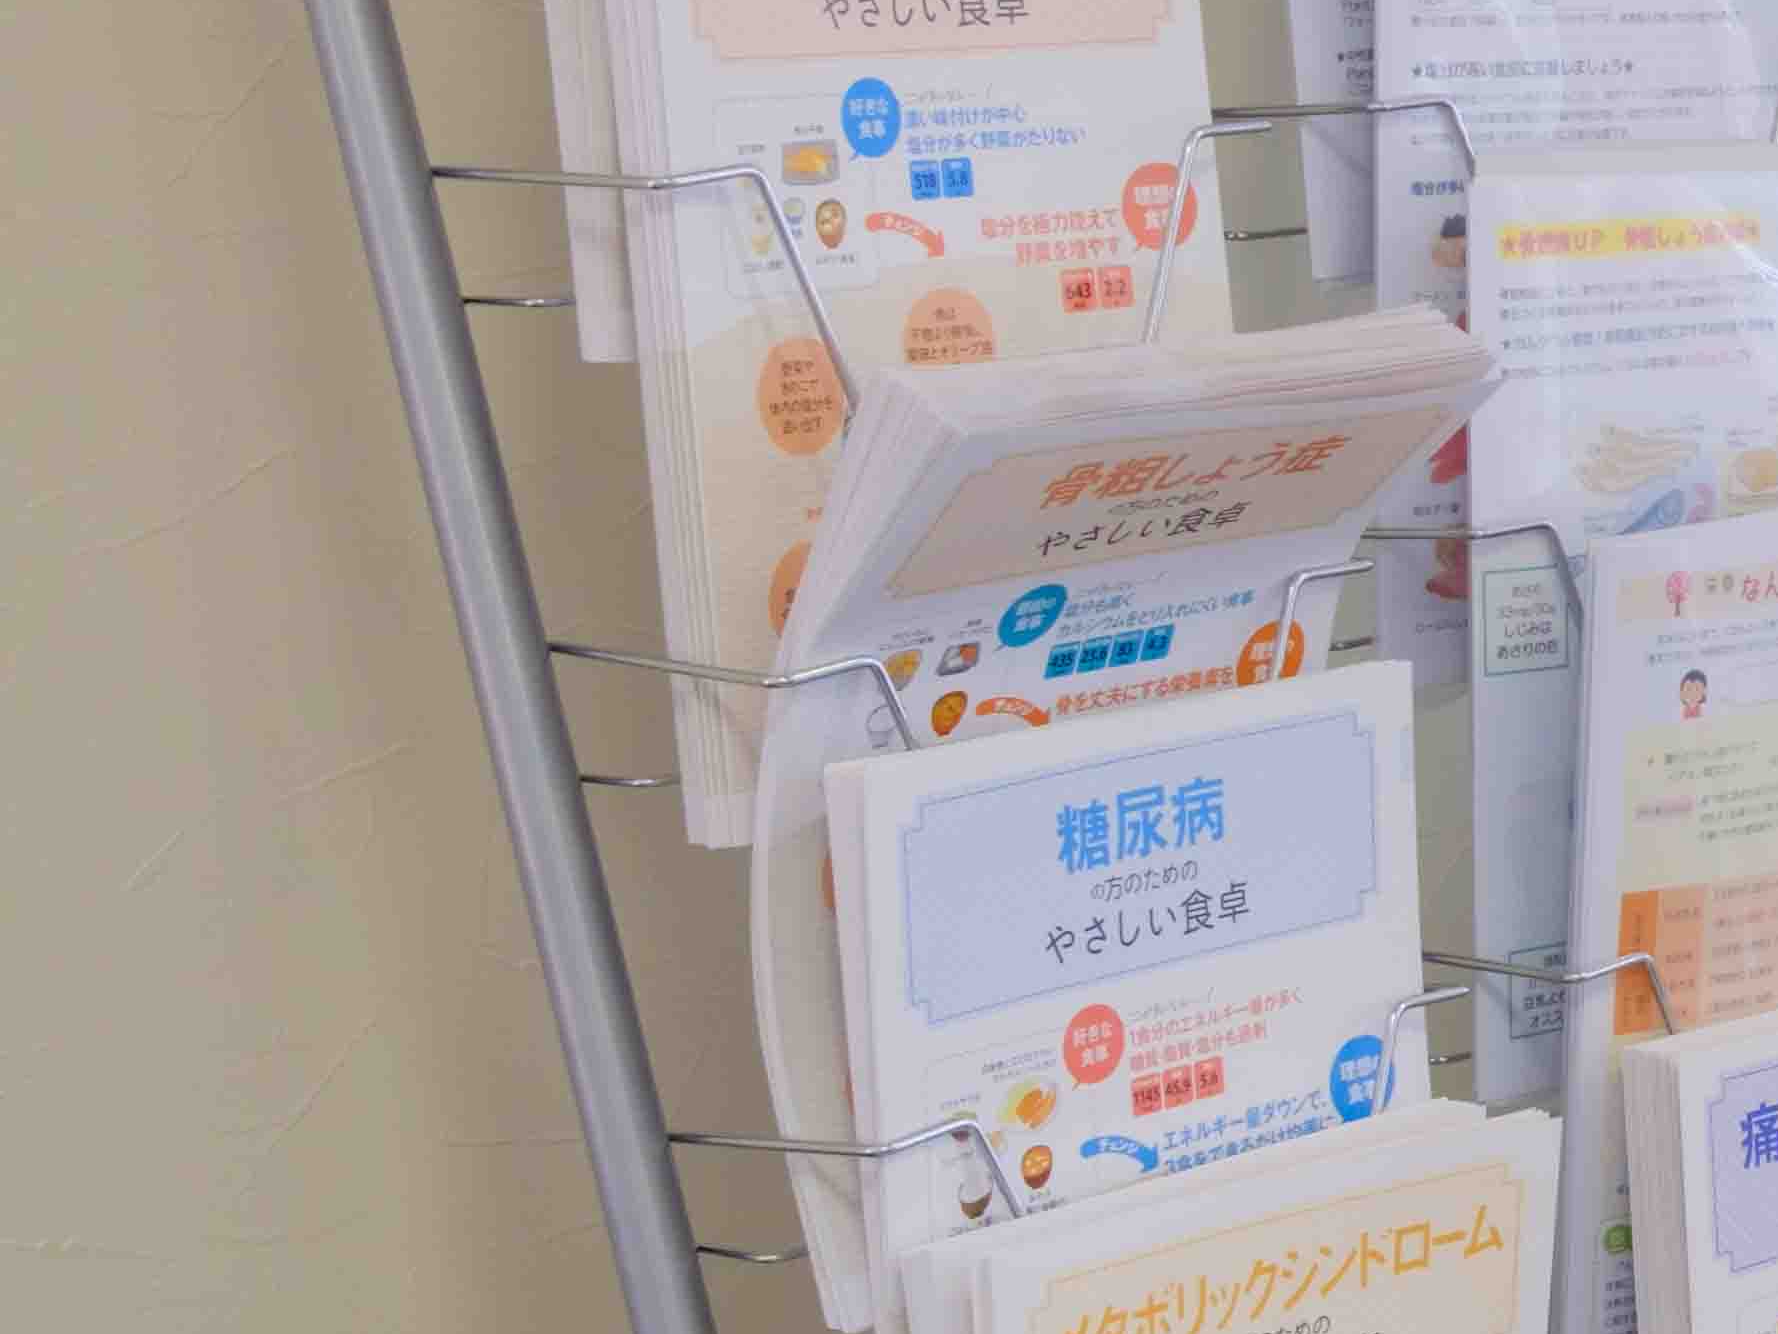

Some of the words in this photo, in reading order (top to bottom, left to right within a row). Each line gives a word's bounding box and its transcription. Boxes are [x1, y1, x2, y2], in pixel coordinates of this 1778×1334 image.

[1039, 435, 1349, 510] 骨粗しょう症
[1039, 502, 1251, 556] やさしい食卓
[1057, 778, 1226, 875] 糖尿病
[1090, 861, 1198, 902] の方のための
[1045, 882, 1251, 964] やさしい食卓
